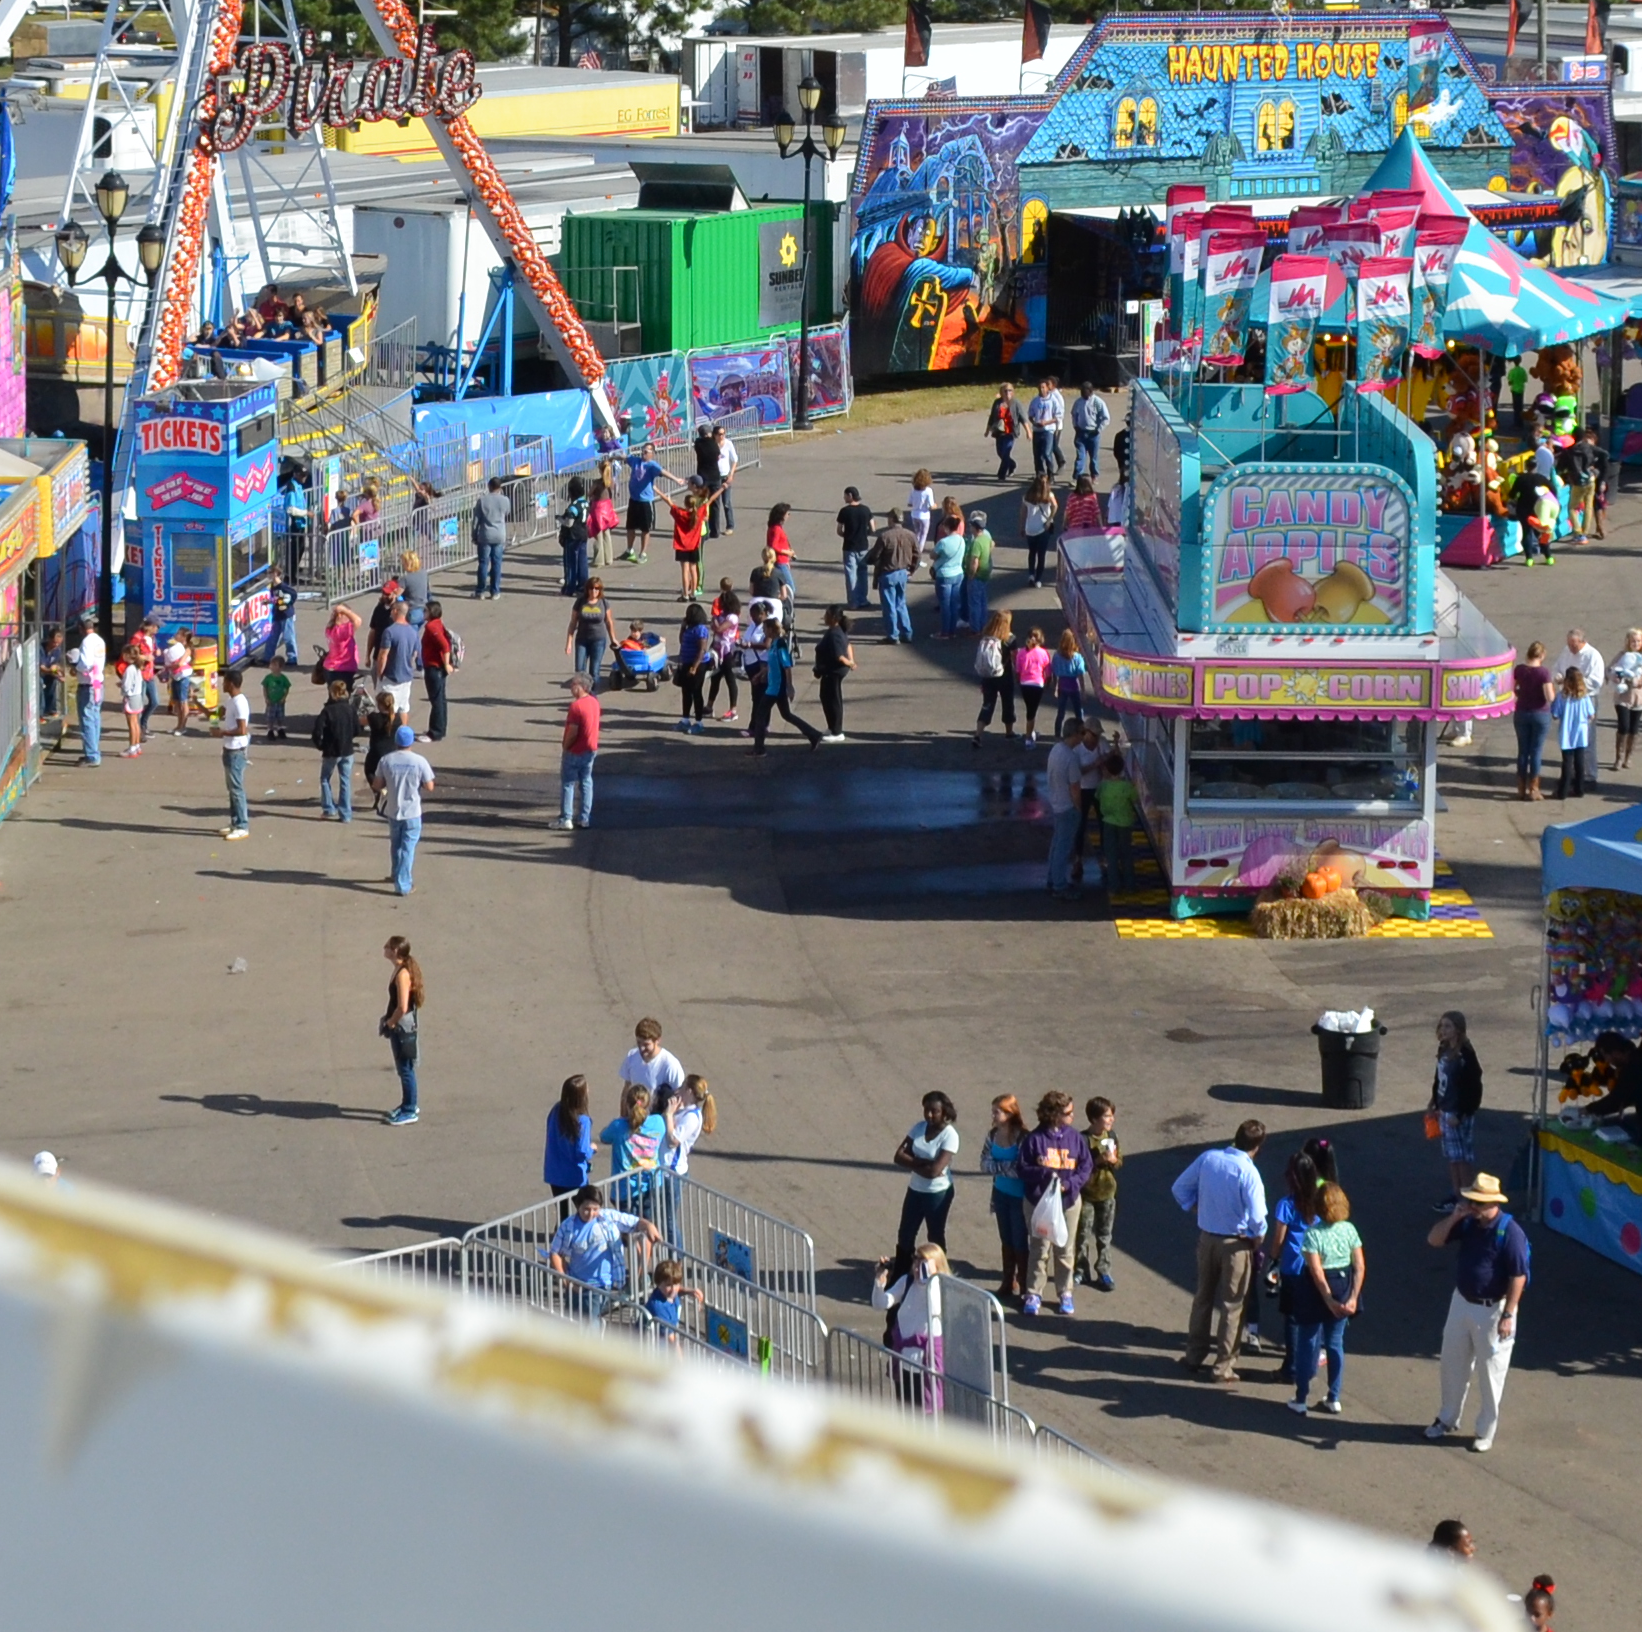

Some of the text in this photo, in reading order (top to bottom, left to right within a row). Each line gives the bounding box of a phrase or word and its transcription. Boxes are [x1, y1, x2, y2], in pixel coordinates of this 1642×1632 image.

[1168, 41, 1380, 84] HAUNTED HOUSE
[205, 23, 482, 155] Pirate
[637, 106, 670, 122] Forrest
[768, 268, 805, 287] SUNBEL
[141, 420, 221, 453] TICKETS
[1231, 486, 1392, 531] CANDY
[154, 525, 164, 599] TICKETS
[1219, 531, 1402, 584] APPLES
[1131, 670, 1189, 699] KONES
[1213, 673, 1422, 701] POP CORN
[1446, 674, 1482, 702] SNO
